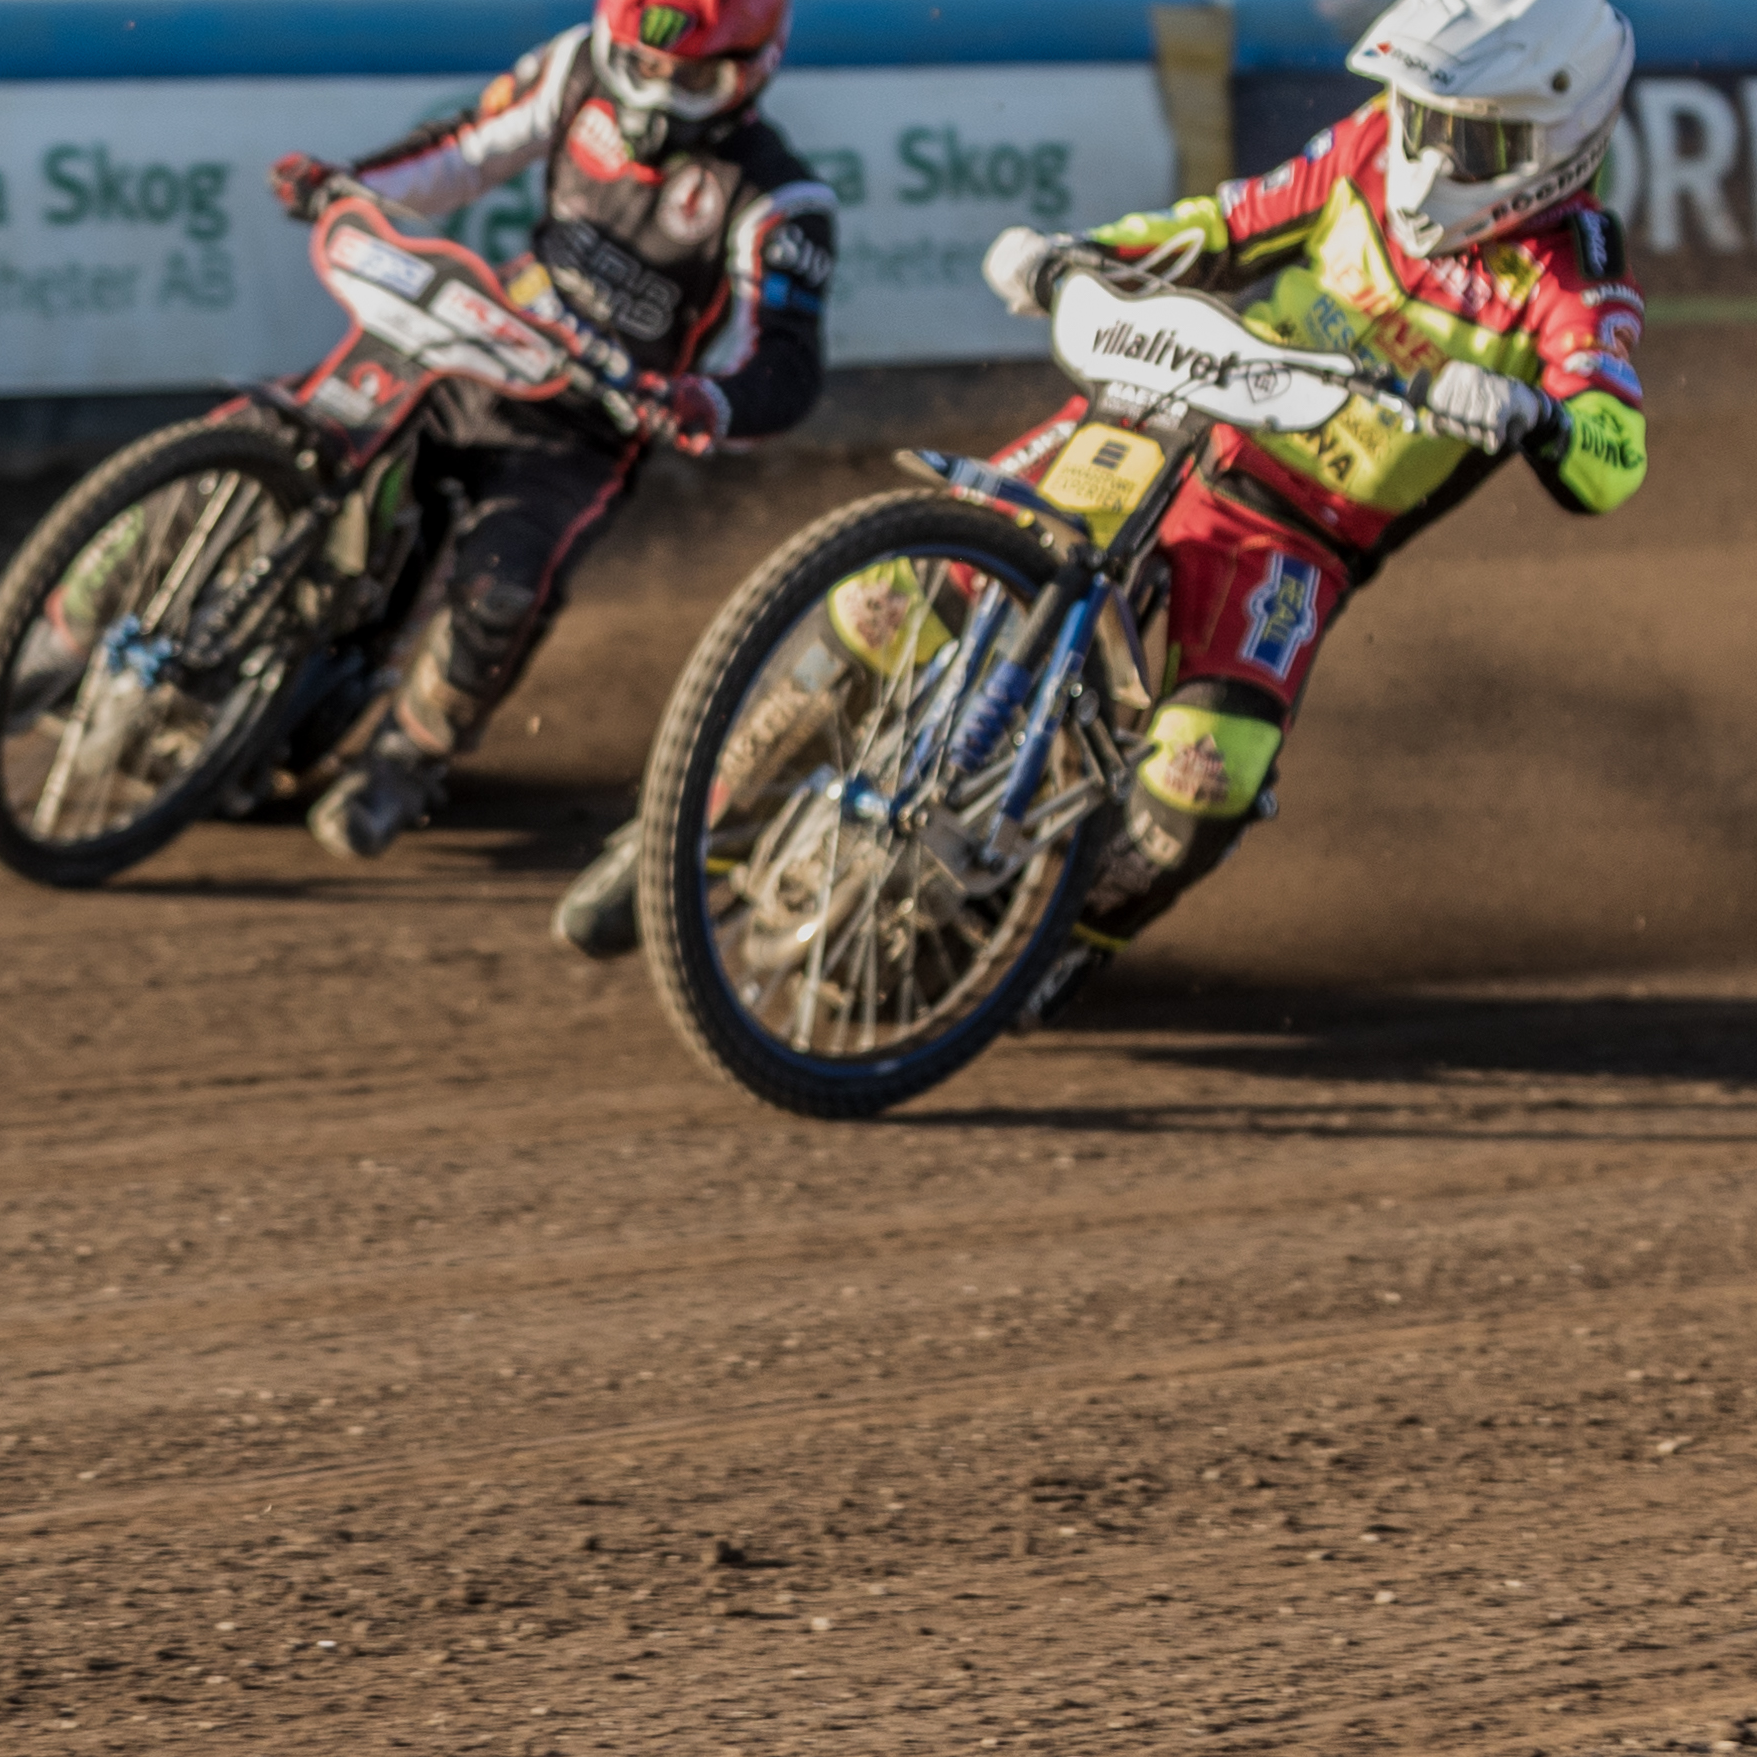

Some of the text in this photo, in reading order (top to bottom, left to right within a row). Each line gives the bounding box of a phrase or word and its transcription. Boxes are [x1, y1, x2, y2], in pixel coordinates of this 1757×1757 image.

[41, 142, 230, 242] Skog
[899, 122, 1073, 218] Skog
[155, 248, 237, 310] AB
[1092, 317, 1241, 390] villalivet
